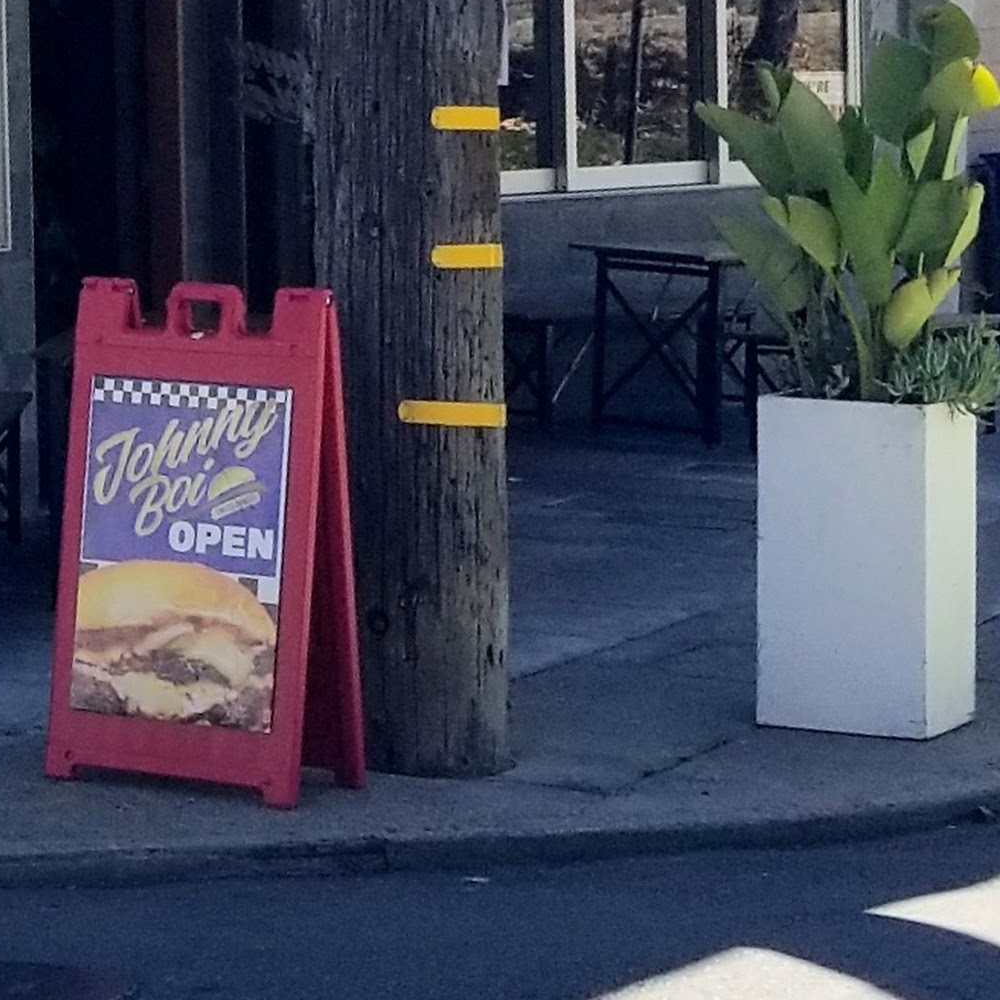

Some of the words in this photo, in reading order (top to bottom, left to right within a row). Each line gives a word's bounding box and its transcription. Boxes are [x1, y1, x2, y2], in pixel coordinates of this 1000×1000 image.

[93, 398, 279, 505] Johnny
[128, 458, 215, 537] Boi
[168, 520, 275, 560] OPEN
